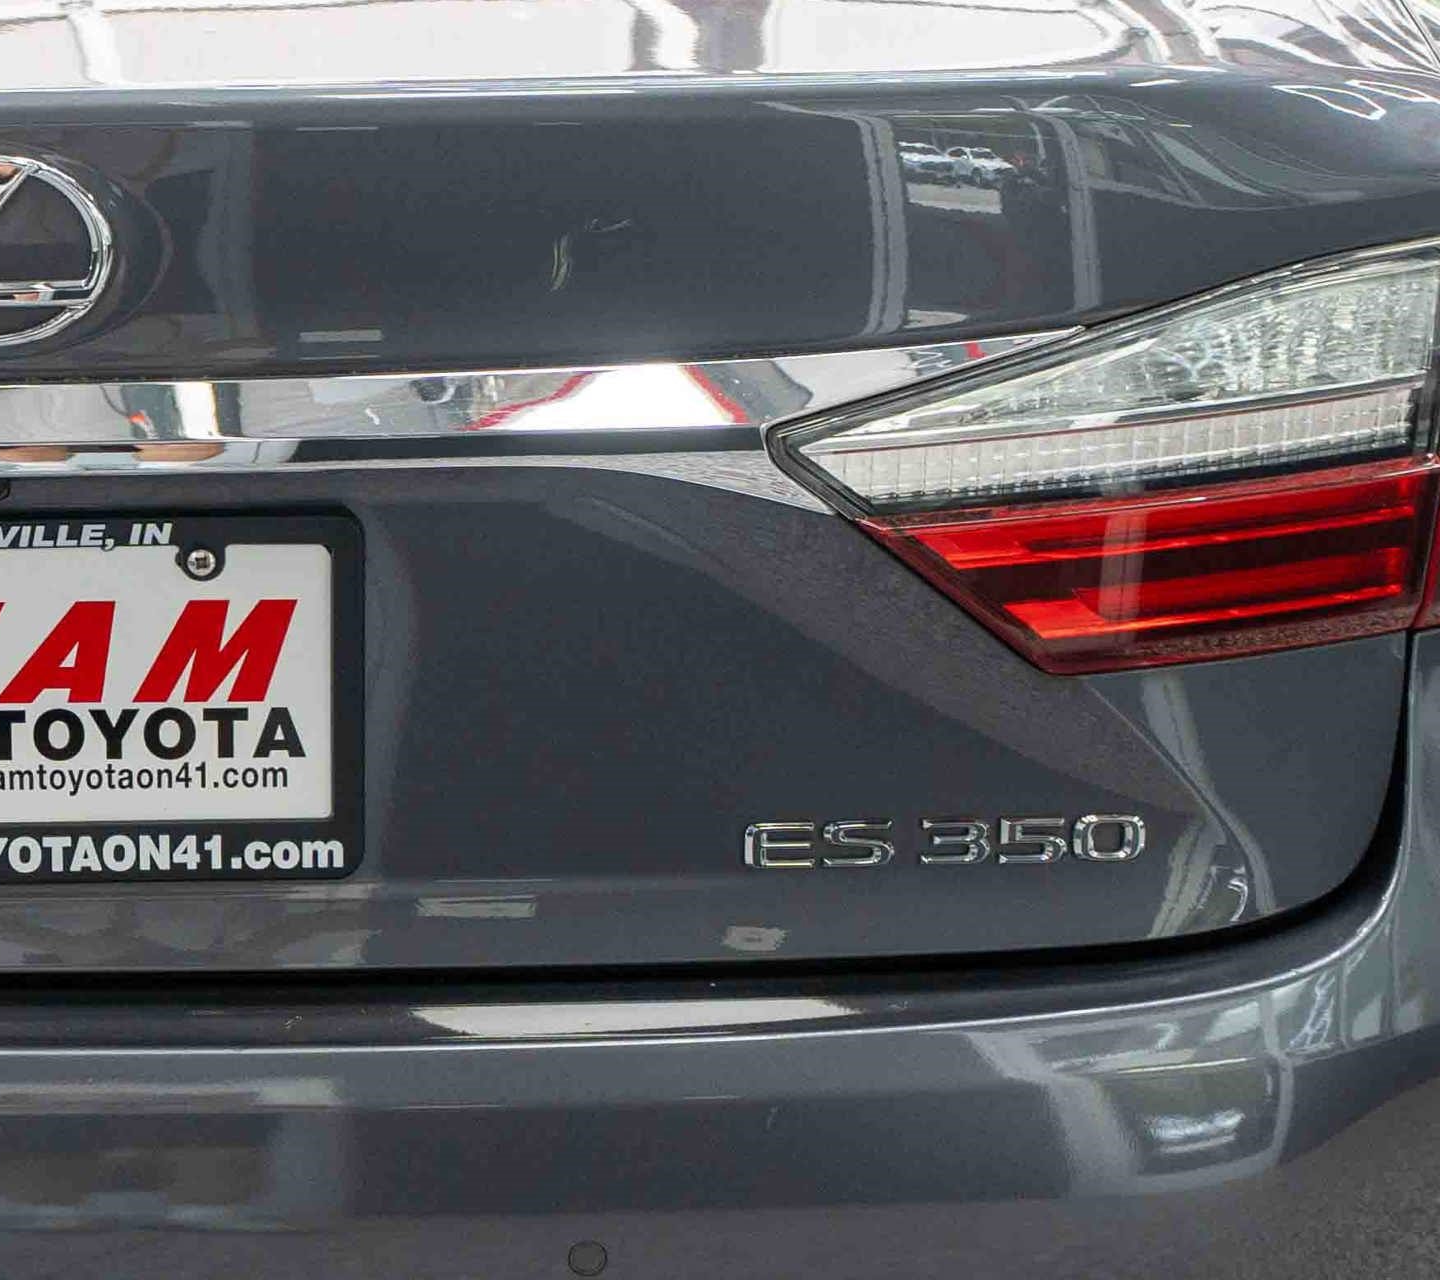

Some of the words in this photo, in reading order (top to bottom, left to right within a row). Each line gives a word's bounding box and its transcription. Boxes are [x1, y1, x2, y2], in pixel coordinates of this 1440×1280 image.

[129, 522, 173, 547] IN
[743, 820, 895, 868] ES
[919, 813, 1147, 864] 350
